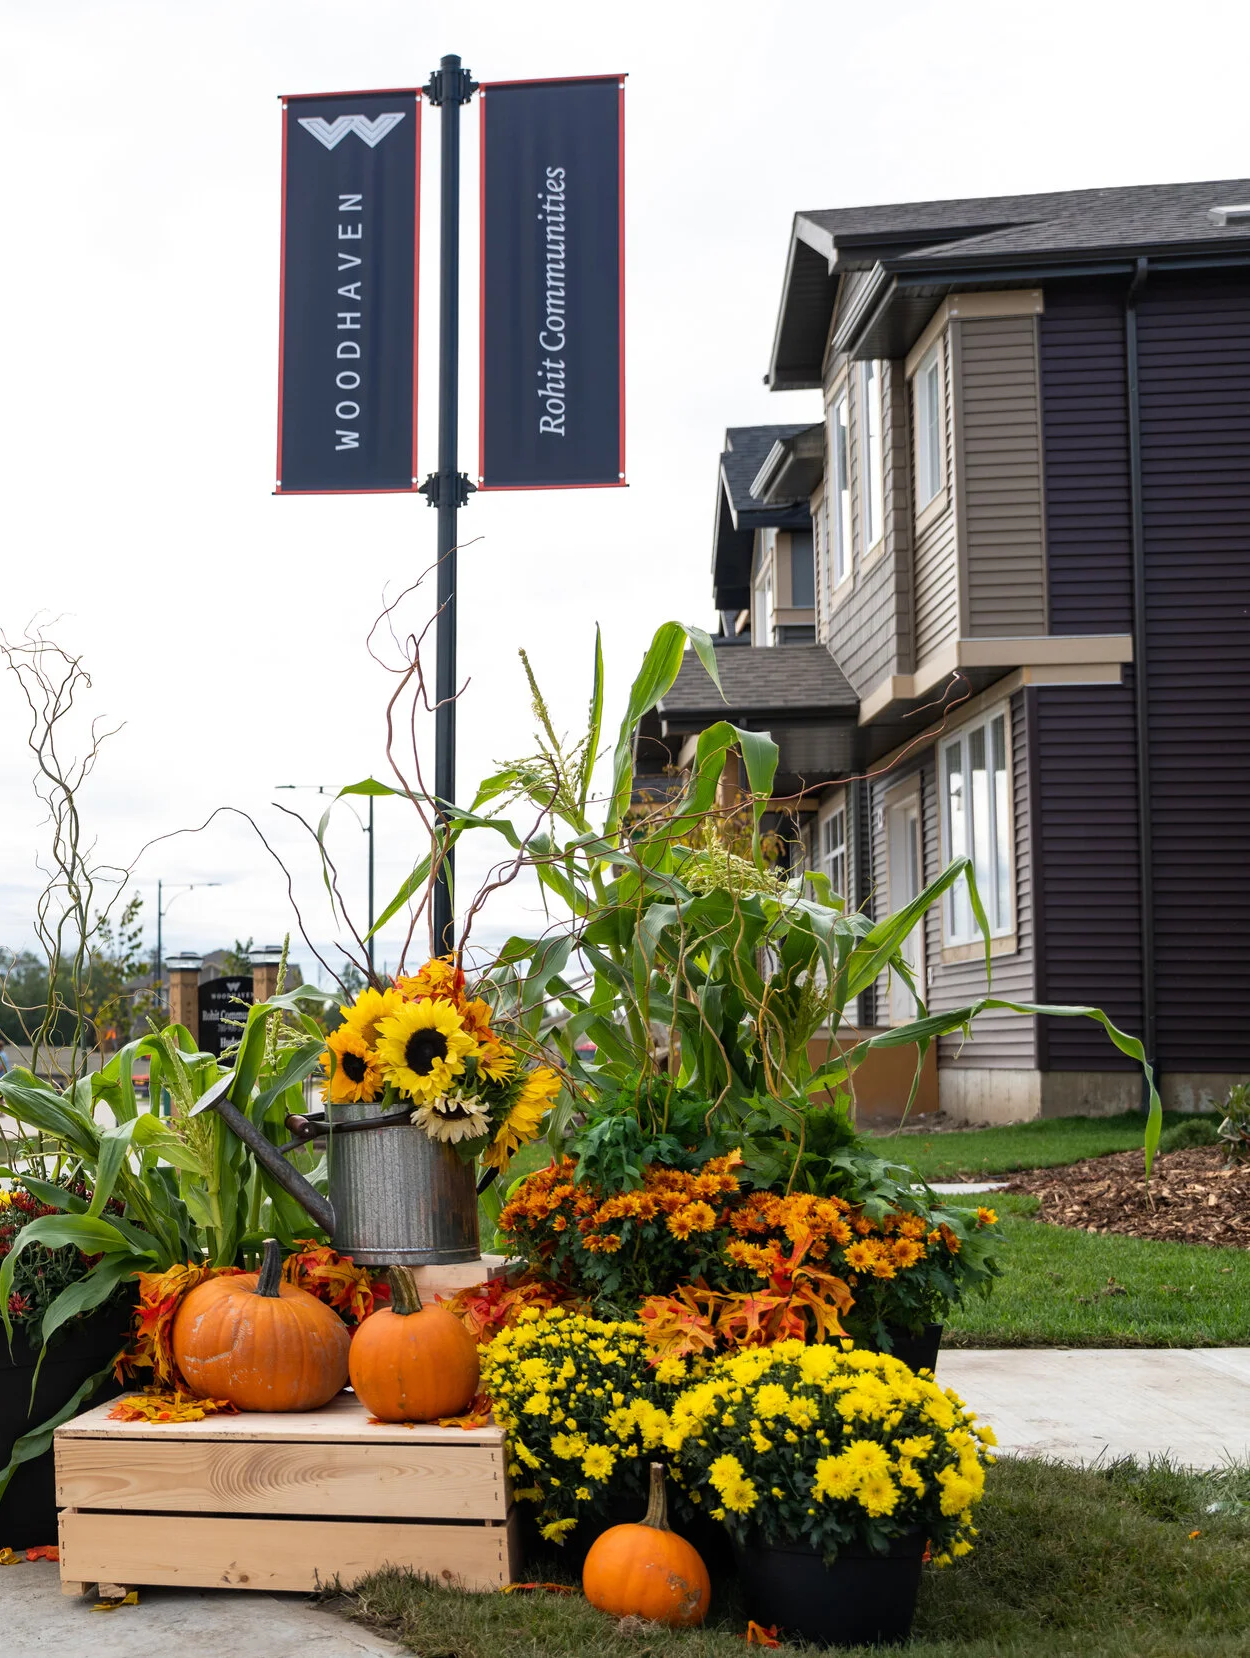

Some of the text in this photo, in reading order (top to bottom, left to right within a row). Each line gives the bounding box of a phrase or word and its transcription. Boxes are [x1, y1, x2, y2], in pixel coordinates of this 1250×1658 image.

[334, 193, 363, 451] WOODHAVEN
[536, 165, 567, 437] Rohit Communities
[202, 1010, 220, 1021] Rohit
